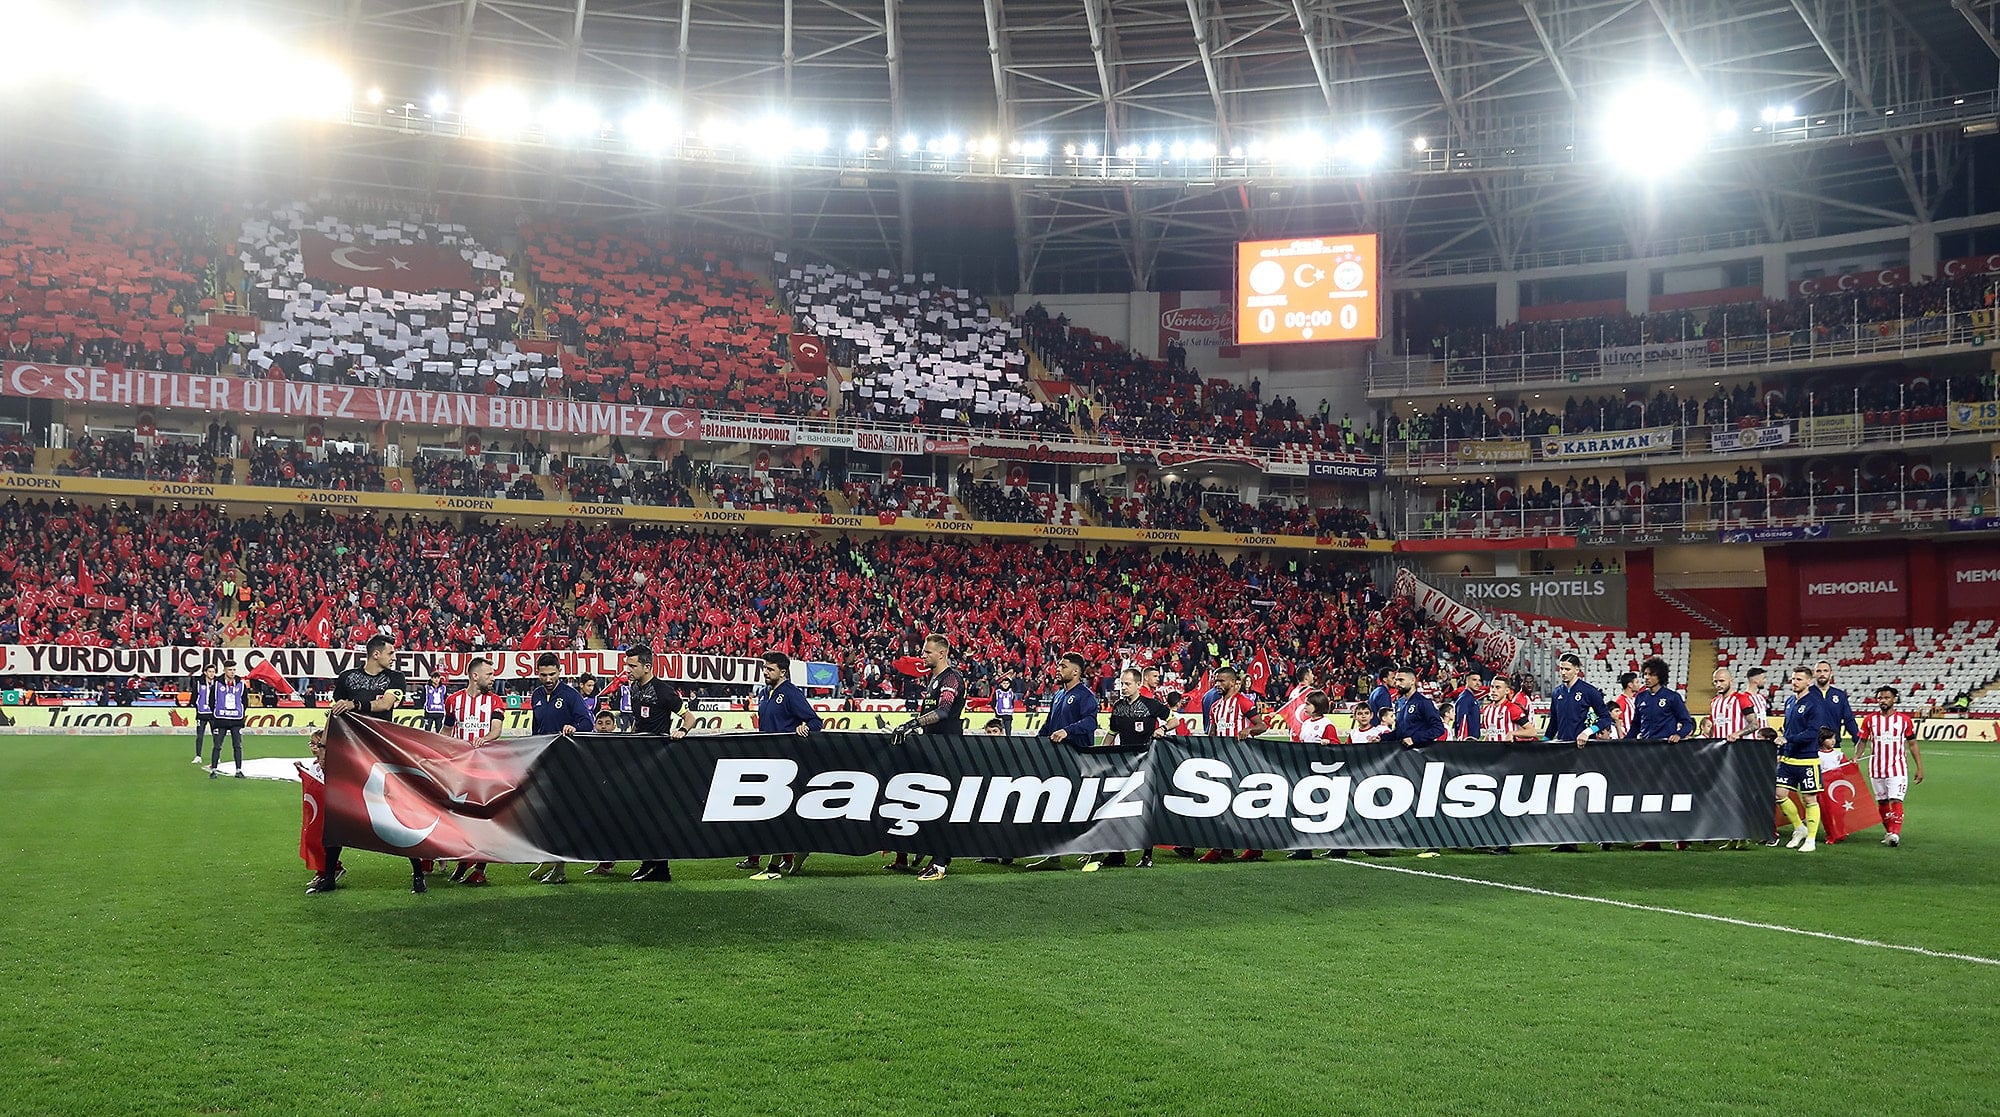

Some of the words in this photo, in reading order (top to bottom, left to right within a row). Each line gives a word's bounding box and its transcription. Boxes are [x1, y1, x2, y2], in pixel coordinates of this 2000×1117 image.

[1258, 308, 1275, 333] 0
[1285, 310, 1332, 328] 00:00
[1340, 304, 1357, 330] 0
[64, 367, 230, 410] ŞEHİTLER
[243, 380, 355, 418] ÖLMEZ
[376, 389, 477, 426] VATAN
[489, 396, 654, 437] BÖLÜNMEZ
[857, 433, 884, 450] BORSA
[893, 435, 919, 452] TAYFA
[1564, 435, 1649, 454] KARAMAN
[6, 476, 61, 489] ADOPEN
[163, 483, 214, 496] ADOPEN
[310, 492, 359, 504] ADOPEN
[447, 497, 494, 510] ADOPEN
[579, 504, 624, 516] ADOPEN
[703, 511, 746, 521] ADOPEN
[831, 516, 862, 527] DOPEN
[935, 520, 973, 531] ADOPEN
[1042, 525, 1080, 536] ADOPEN
[1145, 531, 1180, 541] ADOPEN
[1243, 536, 1276, 545] ADOPEN
[1465, 583, 1522, 598] RIXOS
[1530, 580, 1605, 597] HOTELS
[1808, 580, 1898, 595] MEMORIAL
[27, 645, 161, 673] YURDUN
[244, 648, 315, 675] CAN
[7, 693, 15, 702] C
[511, 697, 517, 705] D
[1914, 719, 1968, 740] Turna
[1802, 777, 1815, 789] 15
[702, 758, 1146, 837] Başımız
[1163, 757, 1693, 834] Sağolsun...
